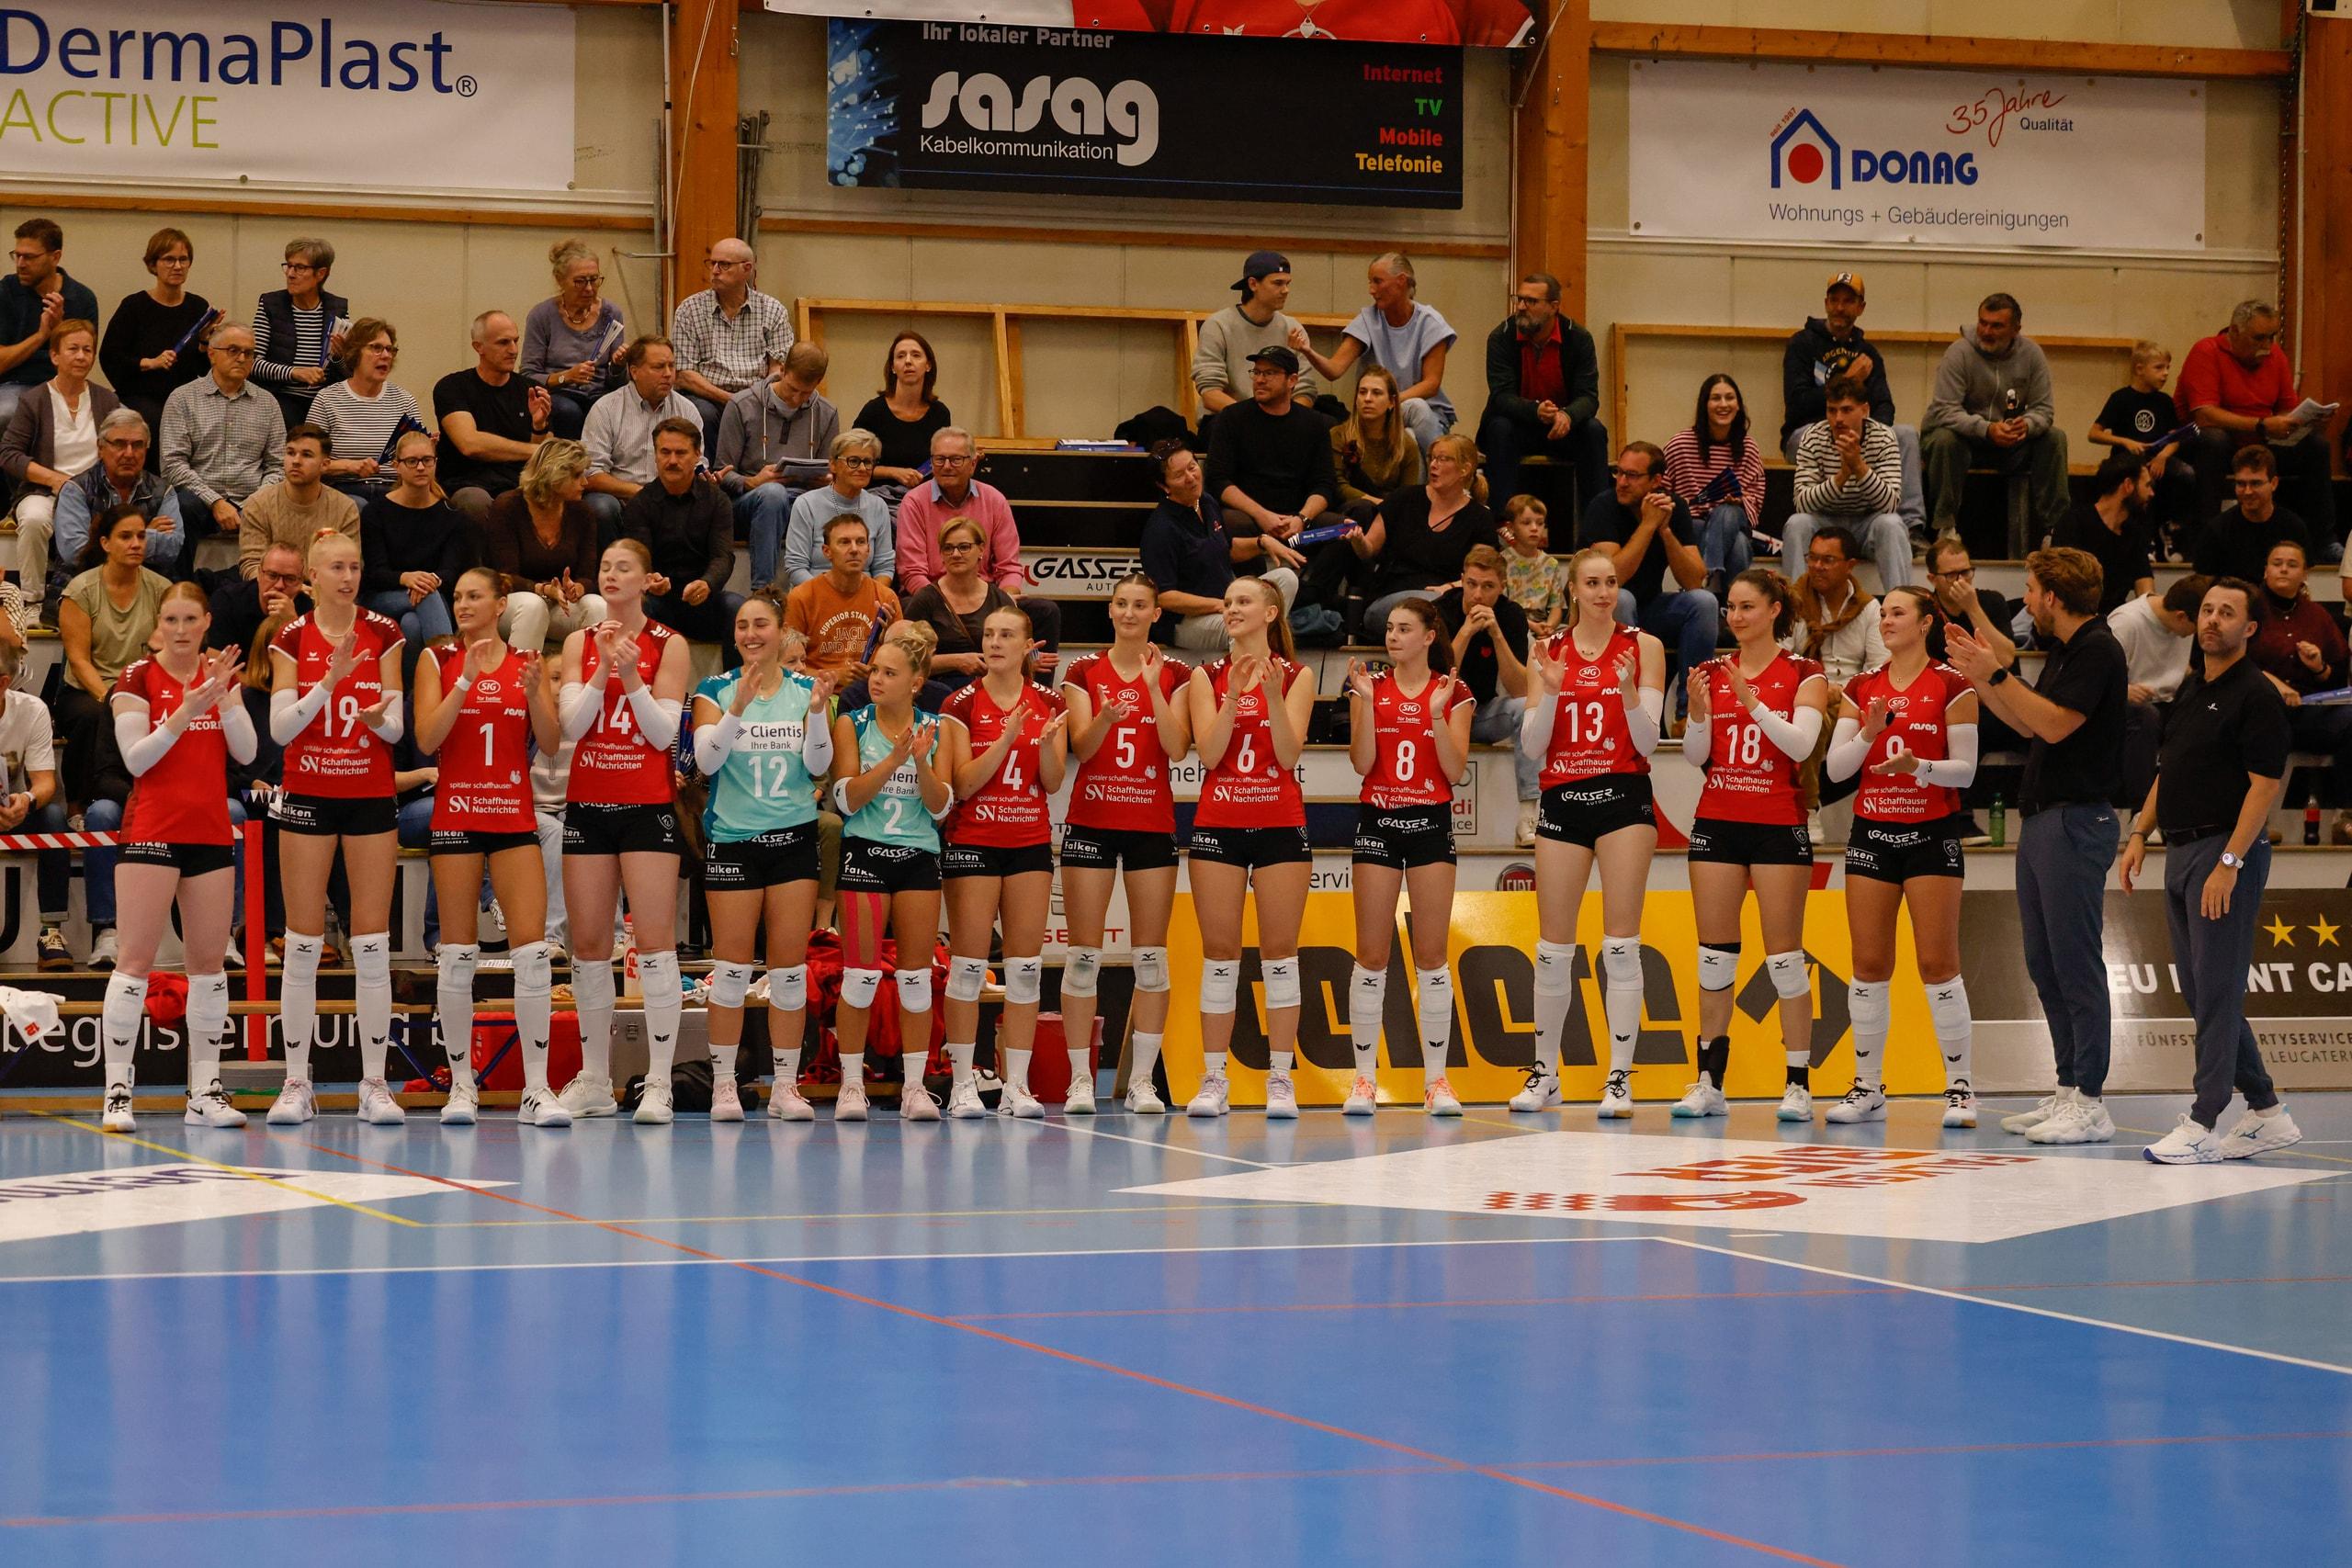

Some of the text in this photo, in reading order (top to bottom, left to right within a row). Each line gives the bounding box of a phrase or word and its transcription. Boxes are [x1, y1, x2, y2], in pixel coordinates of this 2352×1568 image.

[922, 23, 1114, 48] Ihr lokaler Partner
[1363, 64, 1442, 84] Internet
[1415, 98, 1442, 116] TV
[0, 89, 220, 149] ACTIVE
[922, 71, 1159, 167] sasag
[1946, 88, 2067, 148] 35 Jahre
[2020, 117, 2074, 132] Qualität
[1770, 119, 1782, 138] seit
[1380, 127, 1442, 146] Mobile
[921, 135, 1113, 160] Kabelkommunikation
[1355, 152, 1442, 173] Telefonie
[1852, 150, 1978, 186] DONAG
[1770, 203, 2069, 231] Wohnungs + Gebäudereinigungen
[820, 610, 874, 637] SUPERIOR STANDA
[1582, 668, 1597, 676] SIG
[355, 682, 382, 694] sasag
[481, 682, 497, 692] SIG
[1601, 687, 1623, 695] sas
[1120, 692, 1136, 700] SIG
[1239, 698, 1256, 706] SIG
[1402, 704, 1418, 712] SIG
[324, 695, 358, 738] 19
[1140, 716, 1156, 724] sas
[1566, 702, 1604, 743] 13
[751, 725, 802, 739] Clientis
[1909, 722, 1938, 734] sasag
[480, 723, 493, 766] 1
[751, 741, 791, 750] Ihre Bank
[1115, 728, 1136, 769] 5
[1727, 724, 1761, 764] 18
[580, 751, 645, 768] SN Schaffhauser
[1238, 734, 1255, 773] 6
[1396, 740, 1415, 782] 8
[300, 754, 370, 773] SN Schaffhauser
[321, 767, 368, 775] Nachrichten
[596, 761, 641, 770] Nachrichten
[1002, 750, 1023, 791] 4
[749, 755, 788, 798] 12
[1726, 775, 1773, 785] Schaffhauser
[896, 786, 916, 795] Bank
[1085, 784, 1156, 801] SN Schaffhauser
[1213, 785, 1281, 802] SN Schaffhauser
[1566, 788, 1613, 802] GASSER
[1725, 784, 1770, 794] Nachrichten
[449, 795, 521, 813] SN Schaffhauser
[1106, 795, 1152, 804] Nachrichten
[1232, 795, 1279, 803] Nachrichten
[1863, 797, 1928, 814] SN Schaffhauser
[283, 807, 311, 818] alken
[473, 805, 520, 814] Nachrichten
[884, 797, 902, 835] 2
[975, 805, 1041, 822] SN Schaffhauser
[998, 815, 1038, 823] Nachrichten
[751, 832, 793, 843] ASSER
[1192, 835, 1218, 845] alken
[1690, 836, 1706, 845] lken
[1871, 830, 1919, 843] GASSER
[1893, 836, 1931, 848] AUTOMOBILE
[1065, 841, 1098, 853] Falken
[945, 852, 978, 862] Falken
[1507, 879, 1533, 891] FIAT
[1044, 929, 1124, 943] SET
[2108, 964, 2159, 994] EU
[2138, 1031, 2352, 1047] FÜNFST RTYSERVICE
